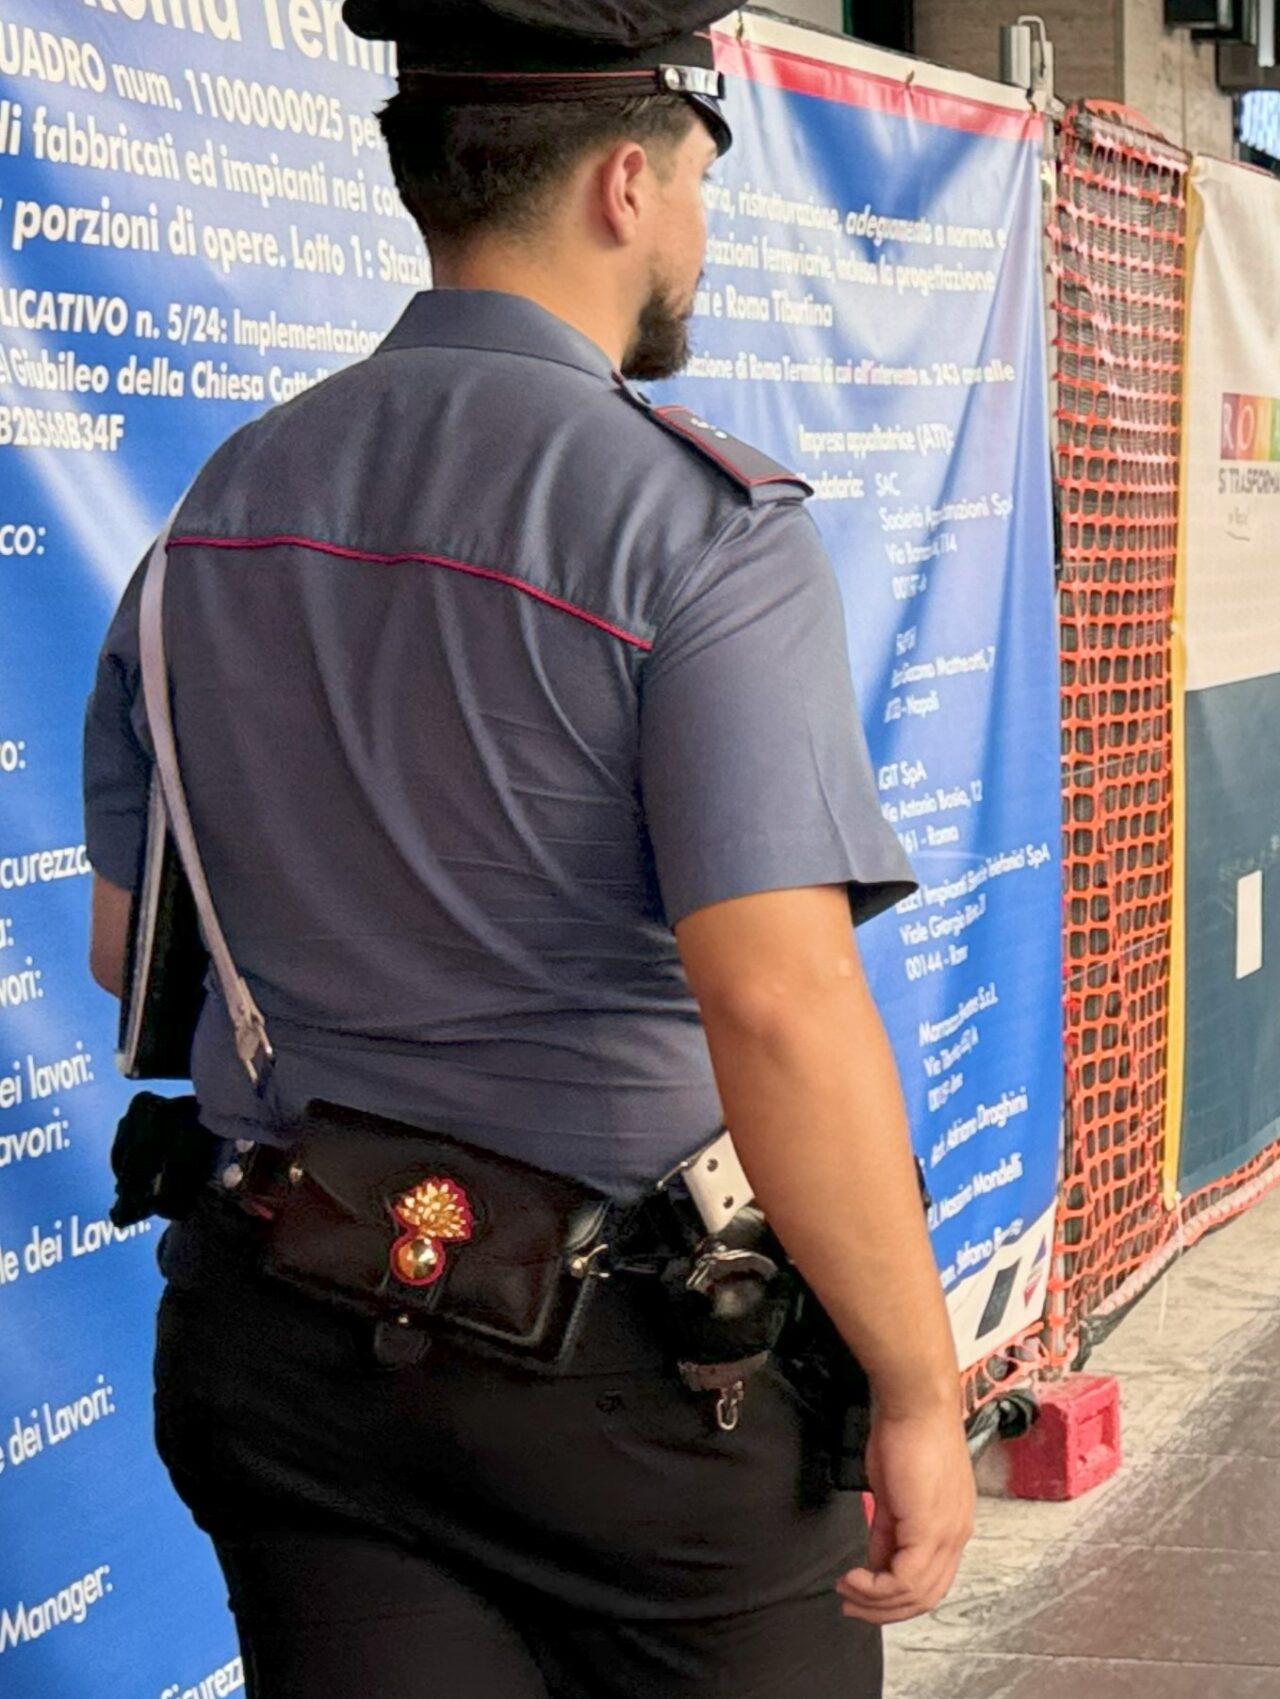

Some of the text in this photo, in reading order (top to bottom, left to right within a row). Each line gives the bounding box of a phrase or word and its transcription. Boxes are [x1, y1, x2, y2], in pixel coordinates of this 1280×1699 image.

[111, 63, 183, 112] num.
[184, 68, 345, 142] 1100000025
[33, 105, 181, 181] fabbricati
[185, 138, 218, 188] ed
[220, 144, 329, 208] impianti
[331, 168, 368, 213] nei
[12, 196, 160, 251] porzioni
[168, 205, 197, 256] di
[203, 224, 287, 274] opere.
[289, 225, 346, 276] Lotto
[350, 235, 374, 279] 1:
[0, 286, 387, 357] LICATIVO n. 5/24: Implementazion
[725, 284, 770, 322] Roma
[10, 348, 110, 393] Giubileo
[117, 355, 185, 397] della
[191, 360, 264, 401] Chiesa
[27, 1041, 95, 1100] lavori:
[25, 1220, 62, 1274] dei
[9, 1407, 43, 1466] dei
[43, 1373, 116, 1446] Lavori:
[0, 1564, 113, 1652] Manager:
